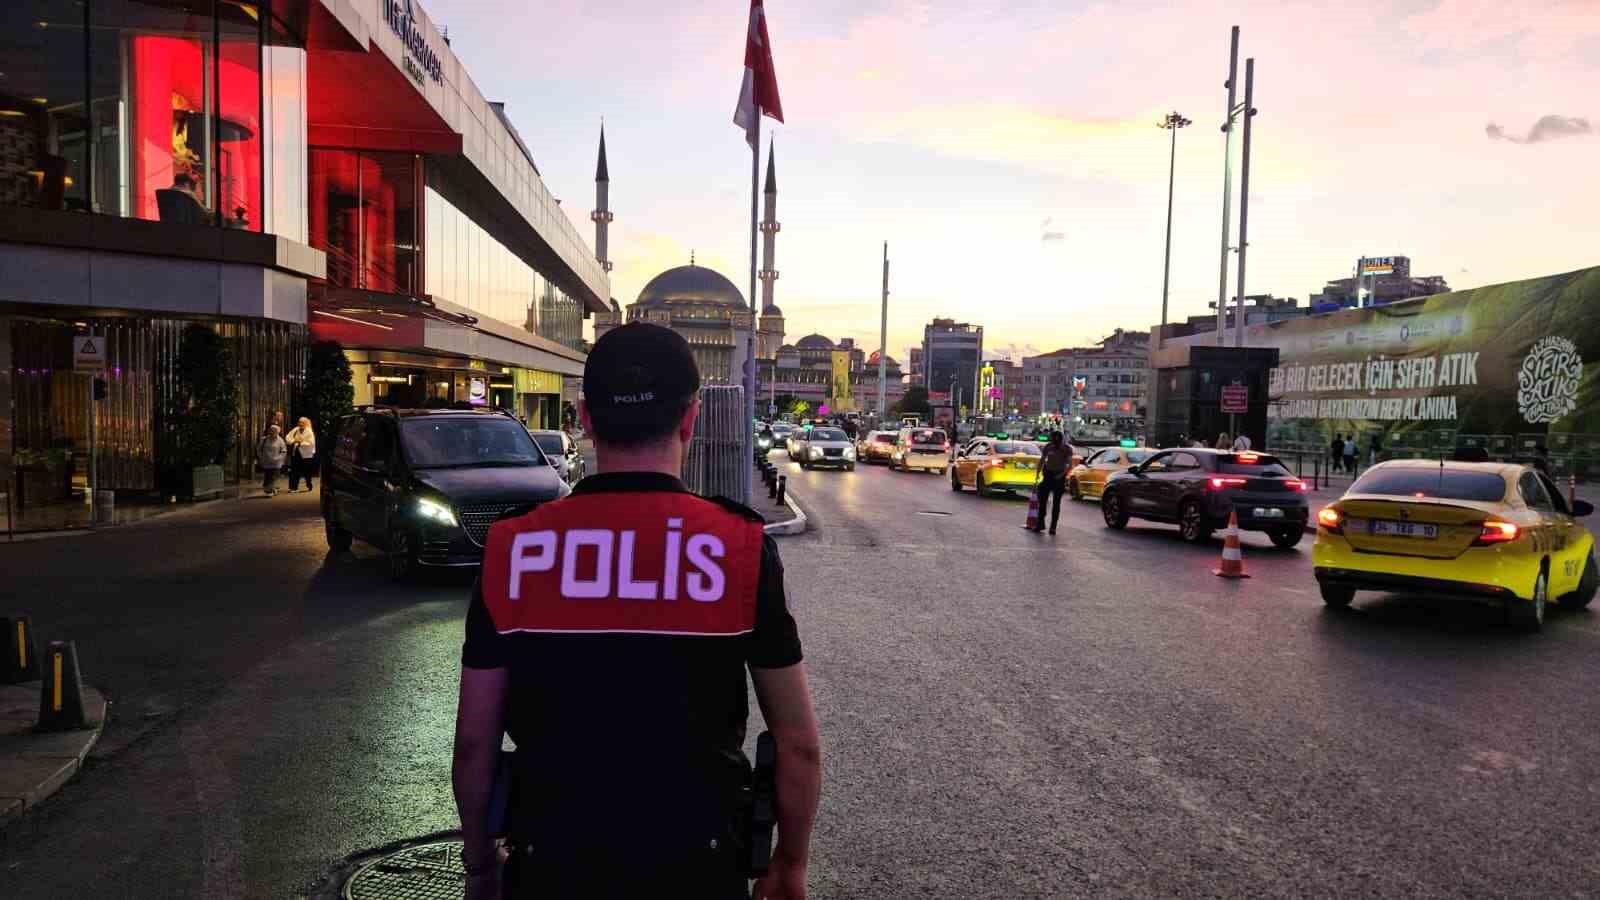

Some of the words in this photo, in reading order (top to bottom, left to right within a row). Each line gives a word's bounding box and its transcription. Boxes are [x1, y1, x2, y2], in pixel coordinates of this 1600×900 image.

[1286, 360, 1306, 392] BİR
[1307, 362, 1363, 391] GELECEK
[1365, 354, 1394, 395] İÇİN
[1396, 356, 1438, 389] SIFIR
[1438, 352, 1480, 386] ATIK
[1520, 352, 1580, 392] SIFIR
[1523, 375, 1580, 406] ATIK
[1380, 398, 1403, 420] HER
[1403, 396, 1457, 420] ALANINA
[508, 517, 726, 602] POLİS
